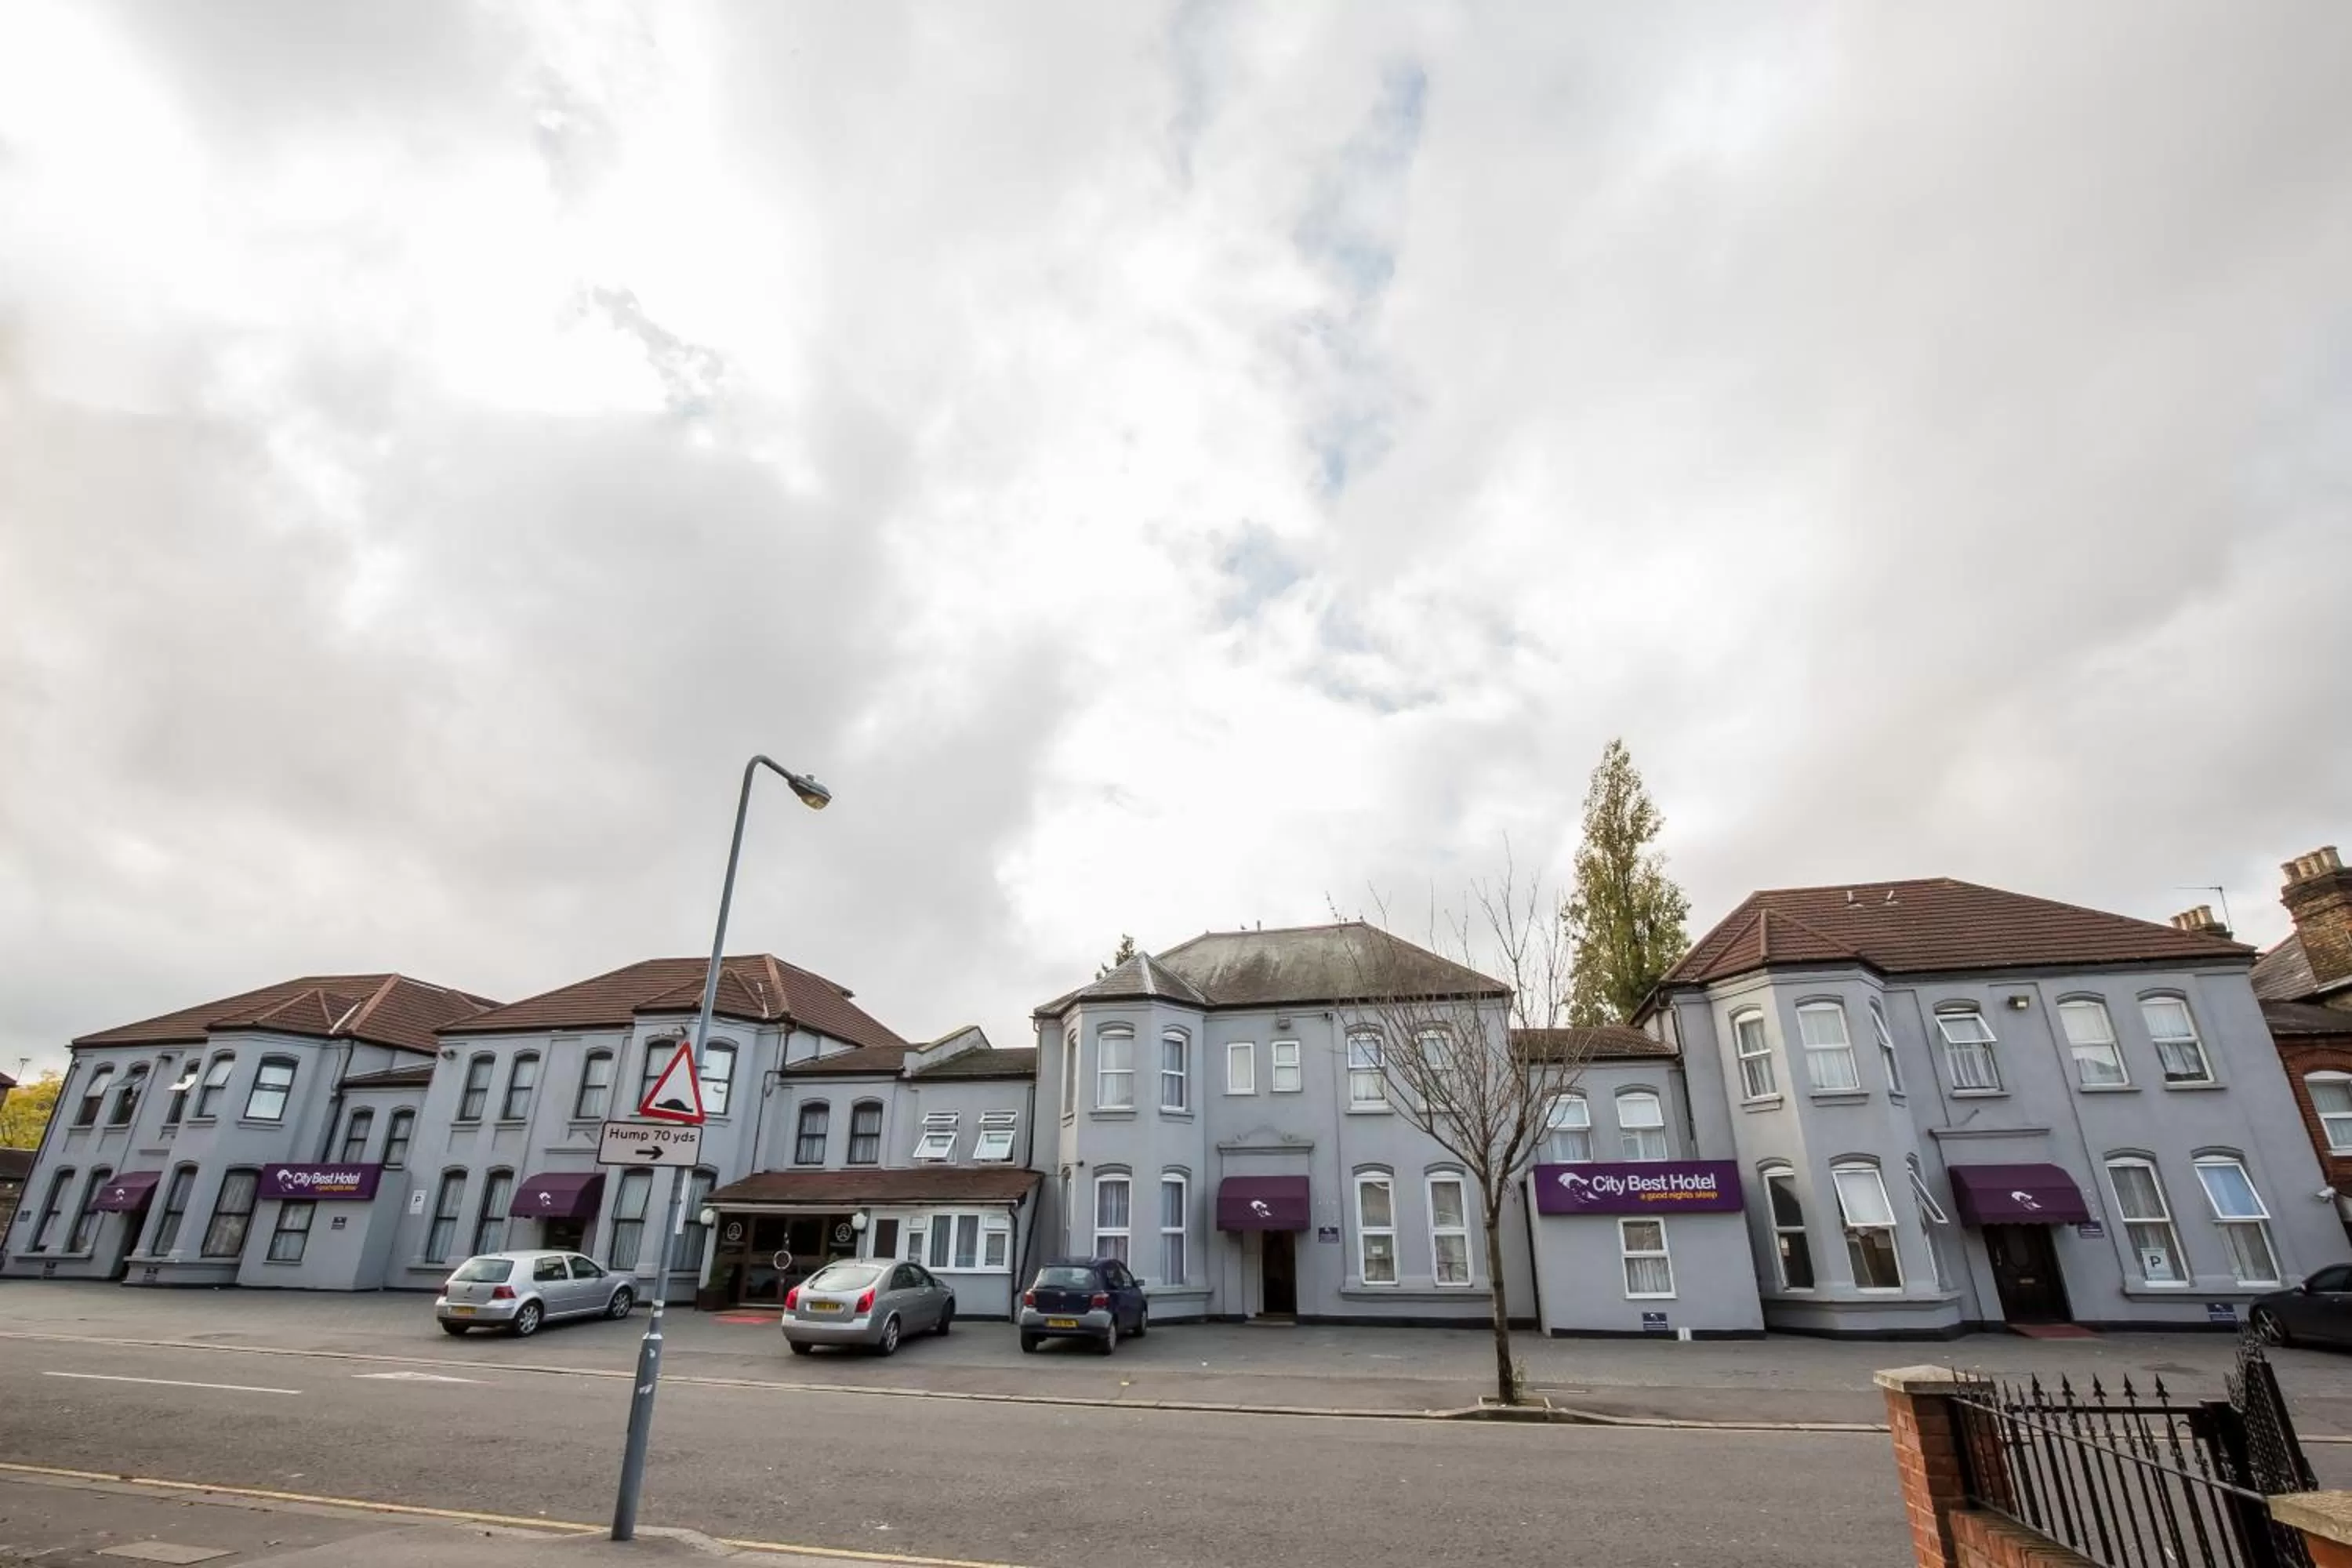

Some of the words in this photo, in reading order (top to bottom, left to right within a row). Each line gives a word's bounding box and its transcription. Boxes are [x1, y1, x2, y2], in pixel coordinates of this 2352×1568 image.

[609, 1128, 648, 1141] Hump
[654, 1130, 670, 1141] 70
[673, 1131, 695, 1143] yds
[293, 1172, 312, 1187] City
[312, 1172, 335, 1184] Best
[334, 1171, 361, 1185] Hotel
[1592, 1175, 1625, 1196] City
[1628, 1174, 1668, 1191] Best
[1669, 1173, 1716, 1190] Hotel
[2150, 1255, 2161, 1267] P
